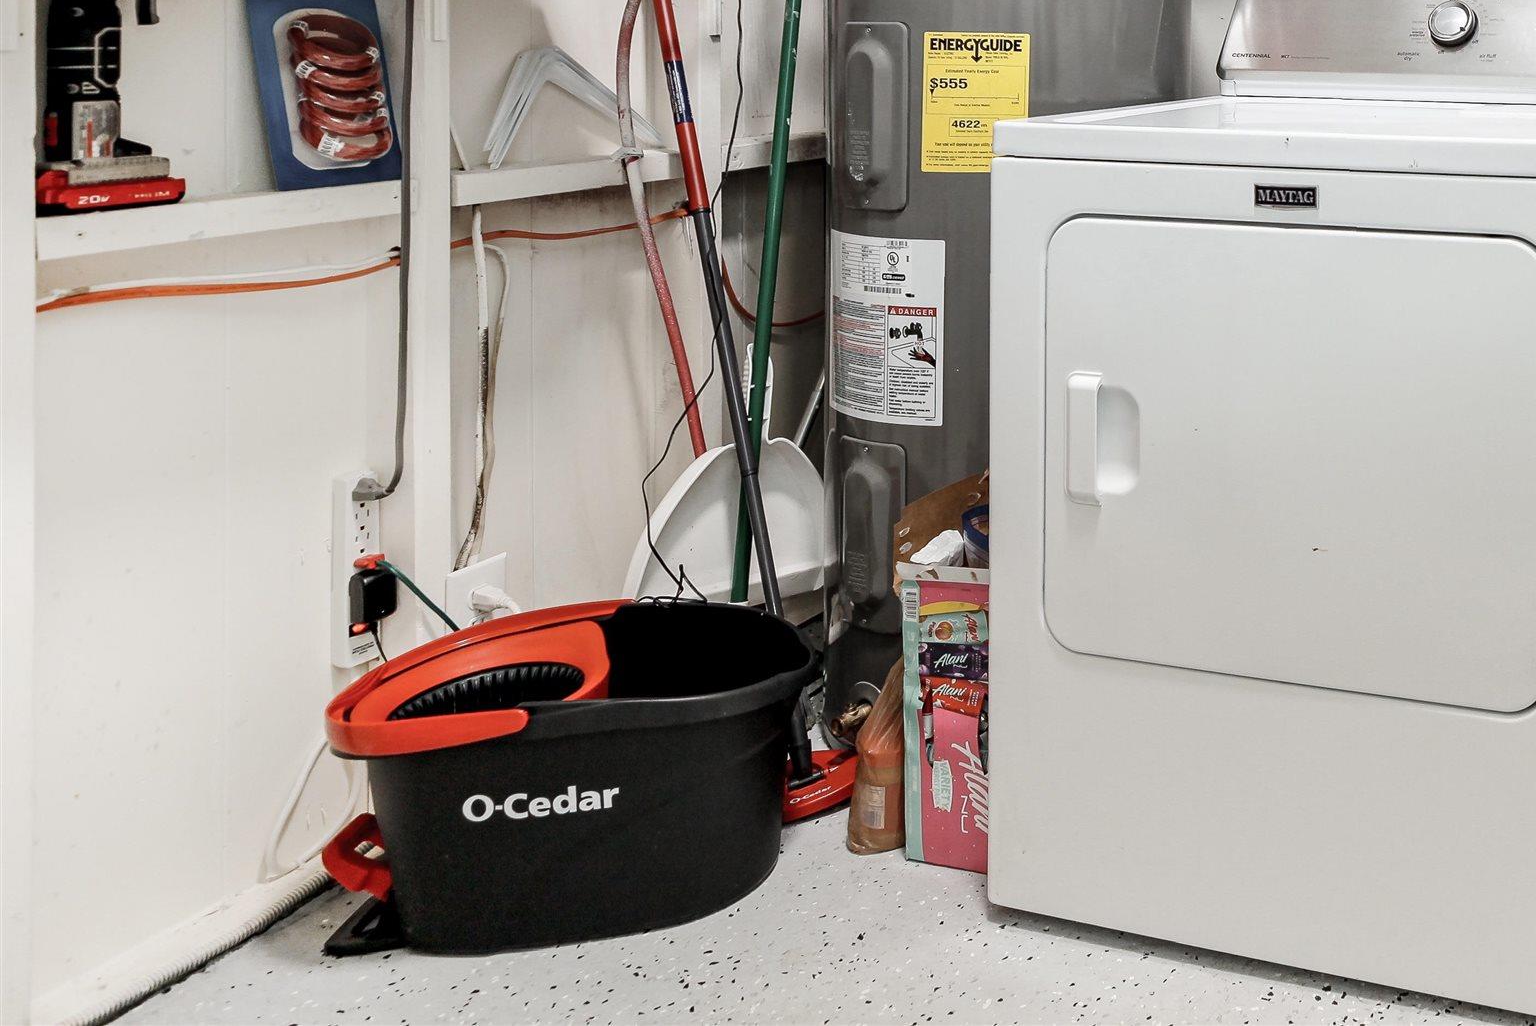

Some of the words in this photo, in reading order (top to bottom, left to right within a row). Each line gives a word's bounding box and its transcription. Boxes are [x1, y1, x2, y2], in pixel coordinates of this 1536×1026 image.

[930, 38, 1022, 56] ENERGYGUIDE
[930, 77, 968, 89] $555
[951, 120, 980, 128] 4622
[1257, 187, 1314, 204] MAYTAG
[898, 308, 934, 316] DANGER
[934, 653, 969, 669] Alani
[932, 683, 967, 696] Alani
[789, 784, 832, 805] O-Cedar
[939, 761, 952, 812] VARIETY
[462, 785, 620, 823] O-Cedar
